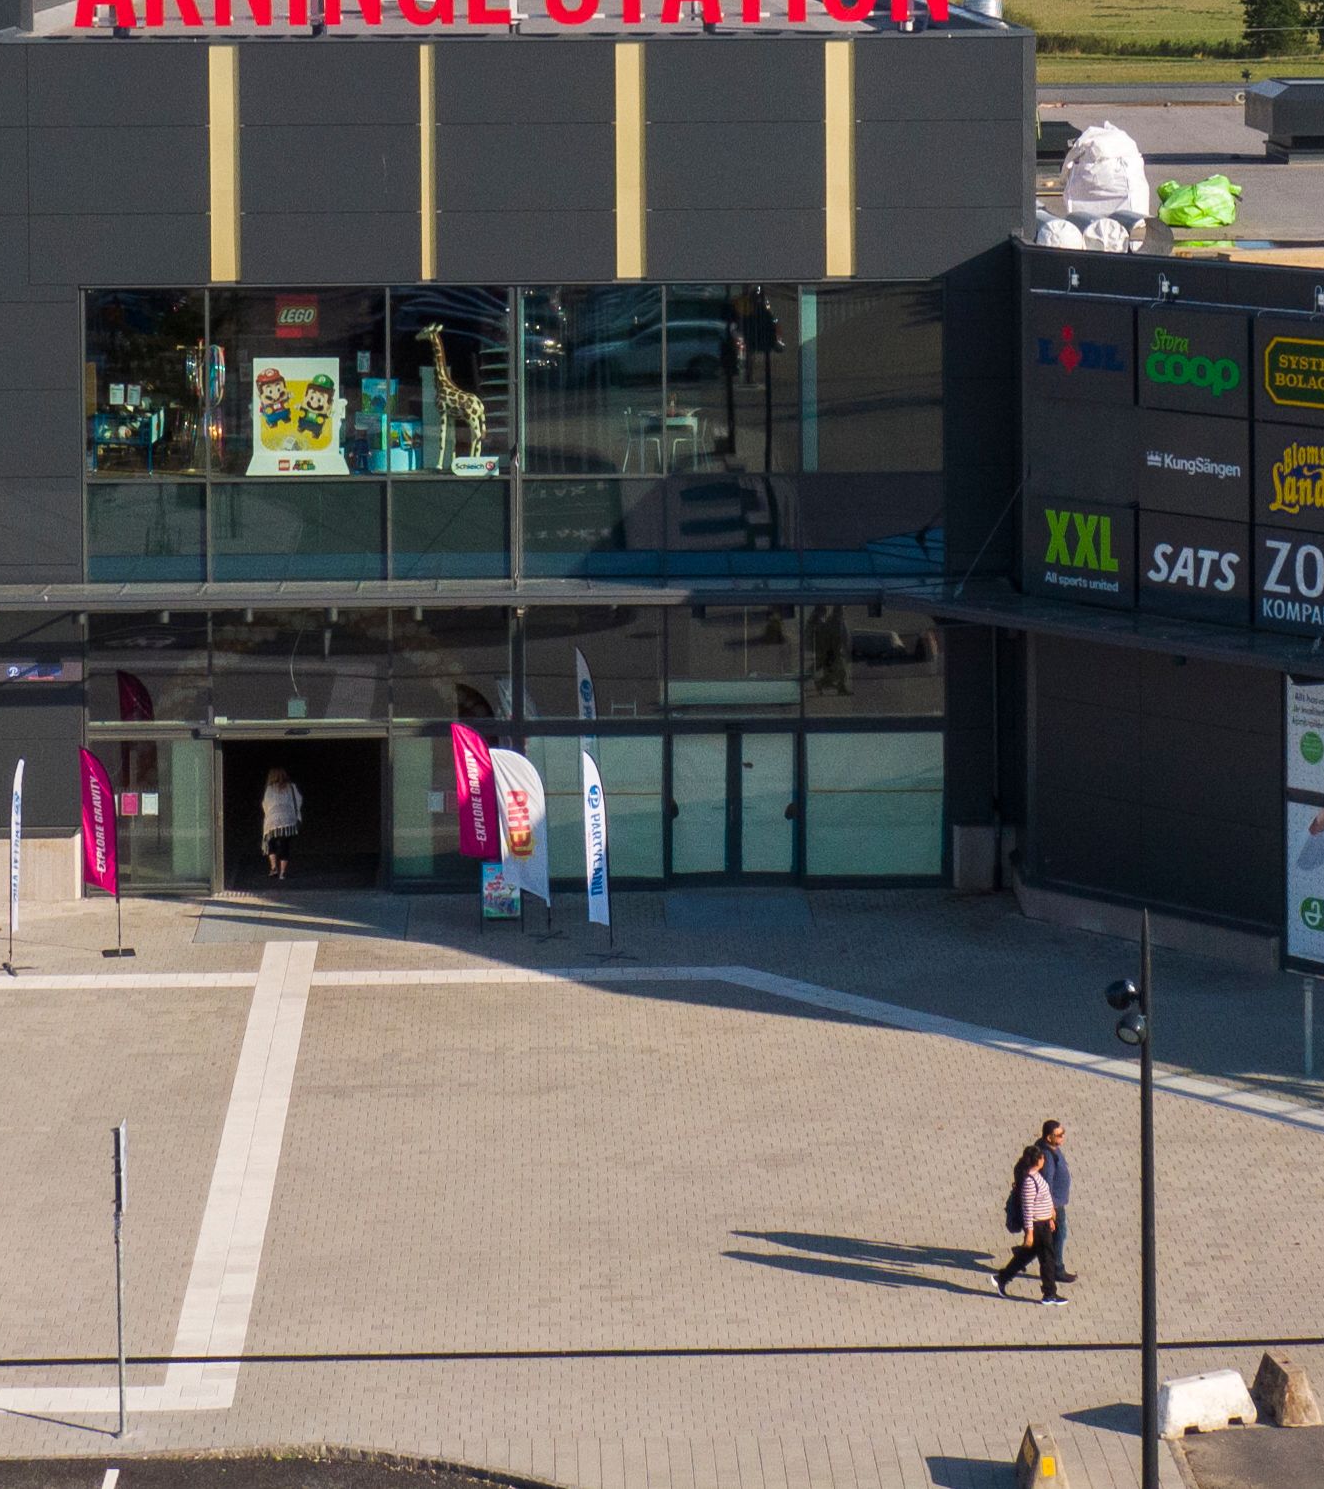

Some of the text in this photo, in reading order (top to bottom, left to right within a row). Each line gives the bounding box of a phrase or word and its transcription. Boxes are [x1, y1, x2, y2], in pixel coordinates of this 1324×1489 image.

[280, 308, 315, 323] LEGO
[1151, 327, 1189, 354] Stora
[1146, 351, 1240, 398] coop
[1163, 453, 1241, 479] KungSängen
[1044, 508, 1119, 573] XXL
[1044, 571, 1119, 593] All sports united
[1147, 543, 1241, 592] SATS
[464, 748, 487, 842] EXPLORE GRAVITY
[89, 775, 107, 873] EXPLORE GRAVITY
